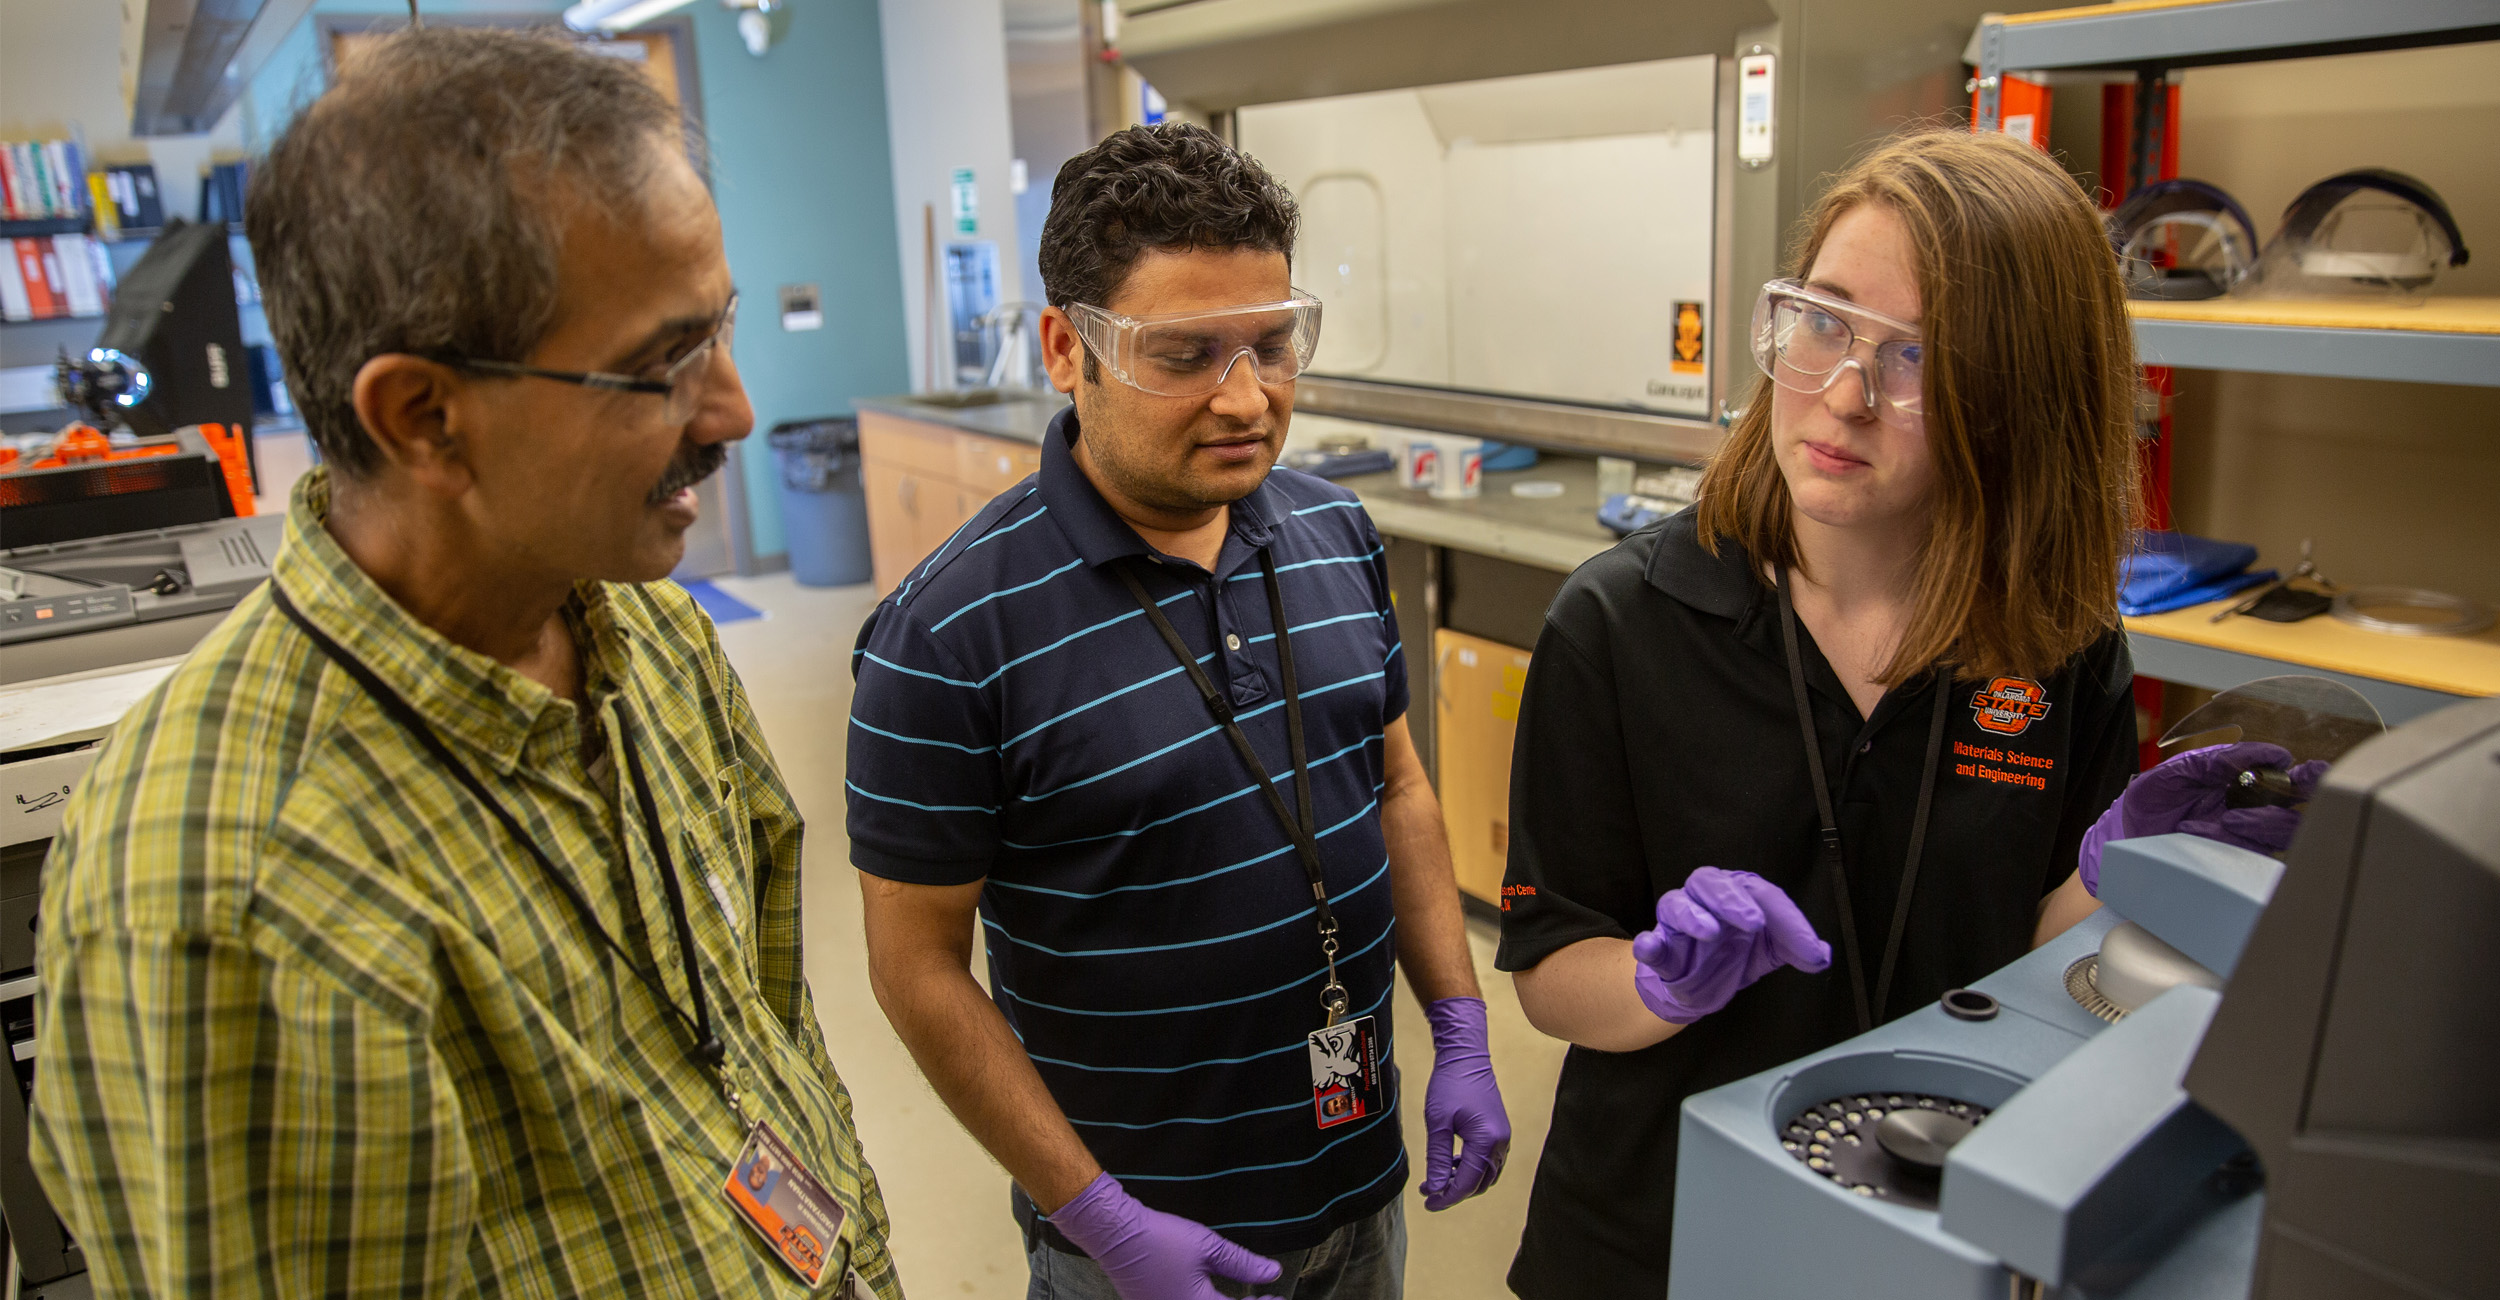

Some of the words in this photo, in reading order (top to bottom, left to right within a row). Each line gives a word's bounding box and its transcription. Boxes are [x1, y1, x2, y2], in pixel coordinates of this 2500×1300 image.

[1974, 694, 2046, 717] STATE
[1985, 707, 2026, 719] UNIVERSITY
[1953, 741, 2003, 762] Materials
[2007, 750, 2054, 769] Science
[1955, 763, 1976, 777] and
[1978, 764, 2046, 790] Engineering
